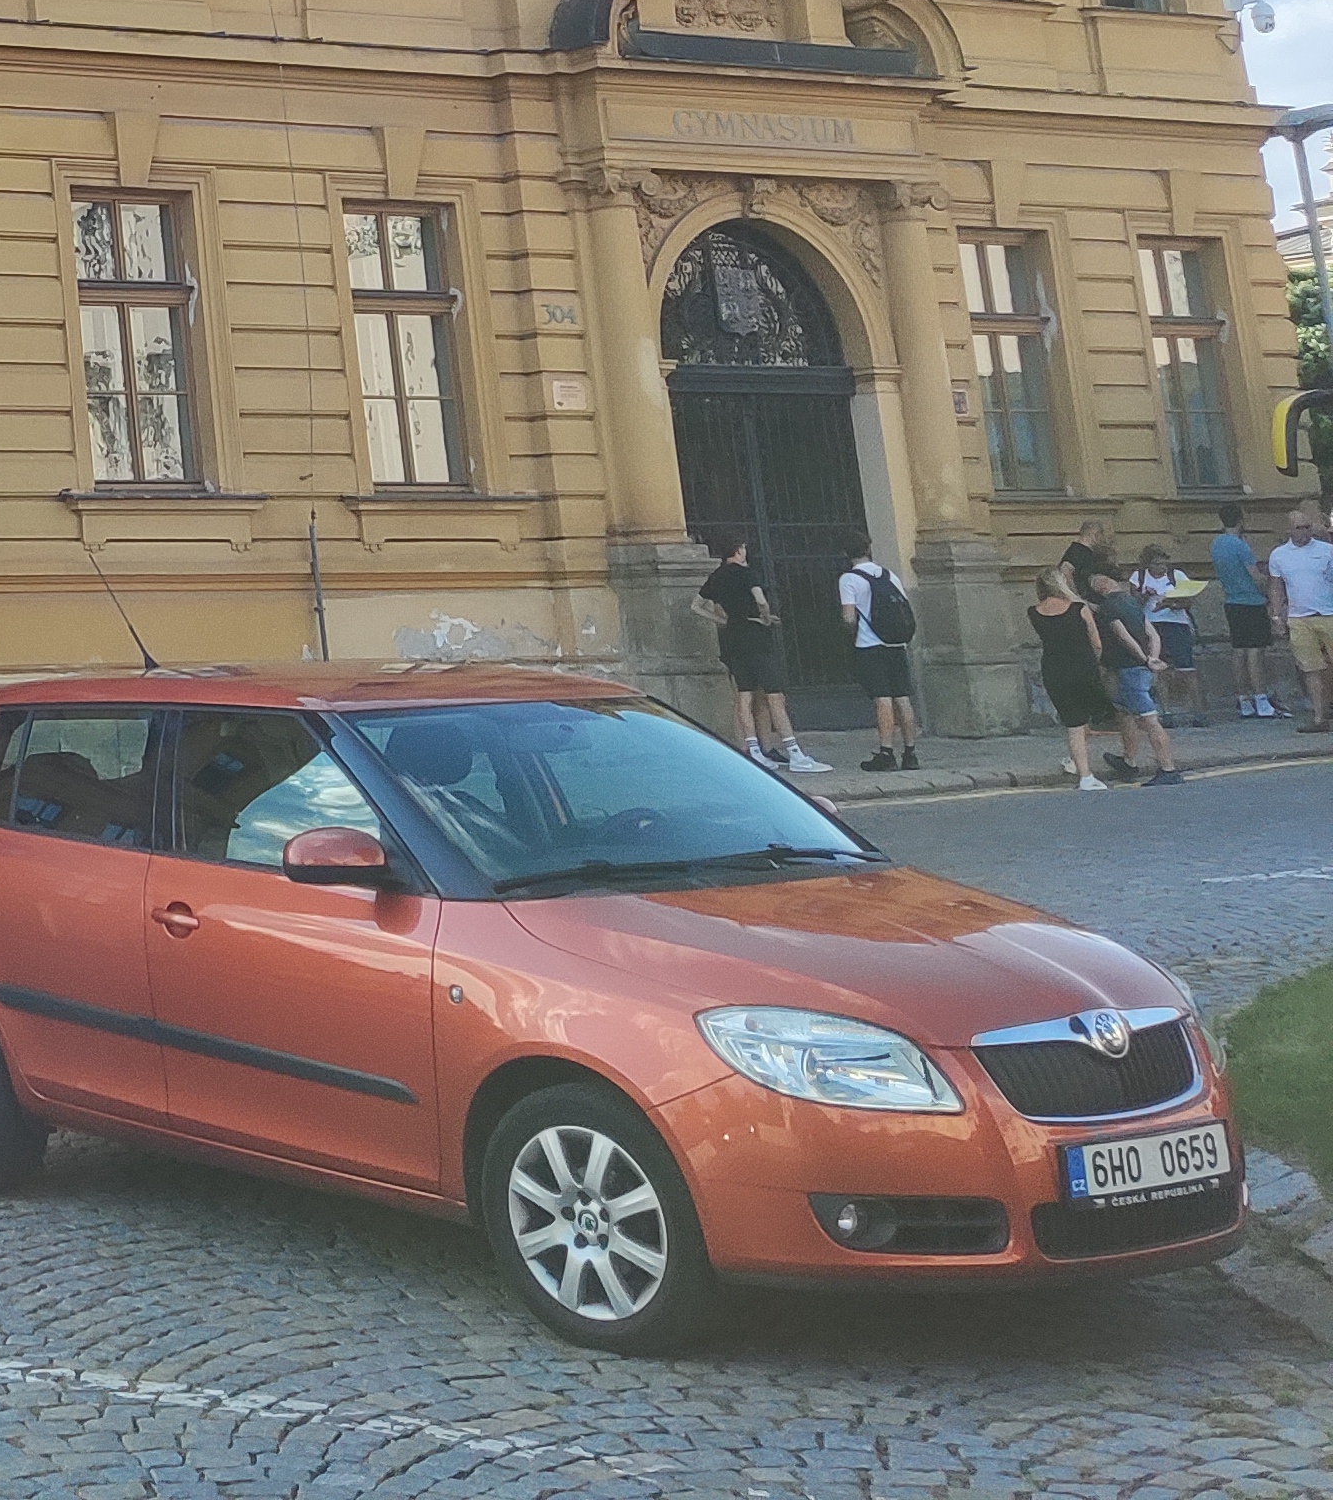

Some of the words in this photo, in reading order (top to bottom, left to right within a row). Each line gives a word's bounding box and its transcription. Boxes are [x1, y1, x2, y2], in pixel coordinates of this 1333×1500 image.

[672, 110, 854, 144] GYMNASIUM
[540, 304, 578, 325] 304
[1159, 1132, 1218, 1177] 0659
[1071, 1179, 1087, 1192] CZ
[1150, 1183, 1205, 1201] REPUBLIKA
